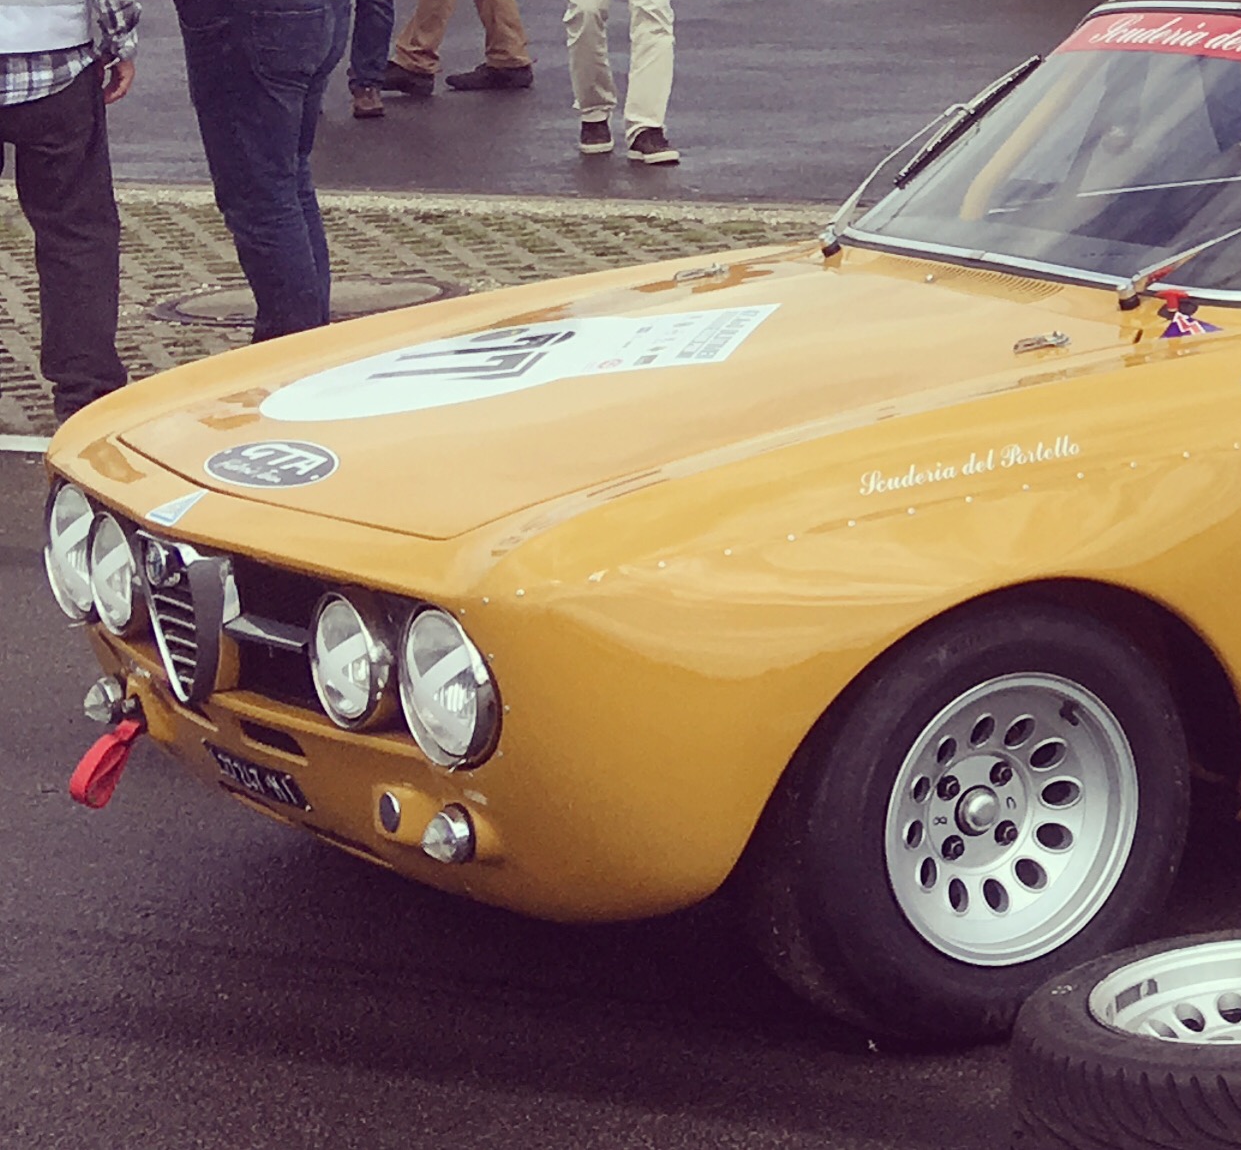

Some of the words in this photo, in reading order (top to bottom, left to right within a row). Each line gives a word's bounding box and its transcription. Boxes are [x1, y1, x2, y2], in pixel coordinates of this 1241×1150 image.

[1089, 14, 1208, 48] Scuderia
[241, 443, 329, 476] GTA
[859, 463, 957, 496] Scuderia
[962, 448, 996, 476] del
[1000, 434, 1081, 469] Portello
